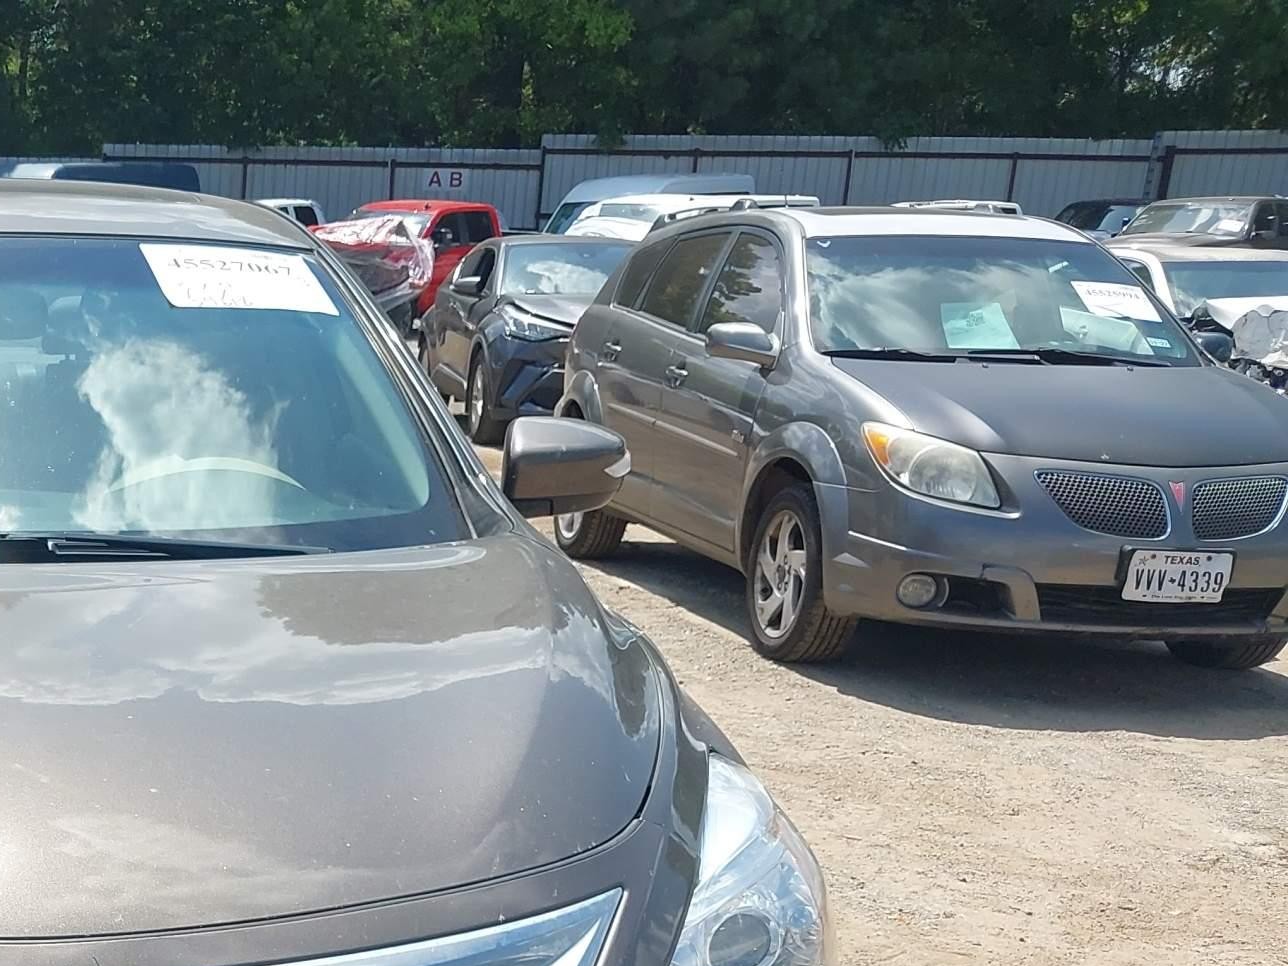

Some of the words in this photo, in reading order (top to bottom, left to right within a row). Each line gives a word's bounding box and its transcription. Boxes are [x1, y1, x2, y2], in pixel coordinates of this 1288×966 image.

[428, 171, 442, 187] A
[449, 172, 463, 187] B
[1164, 555, 1201, 566] TEXAS
